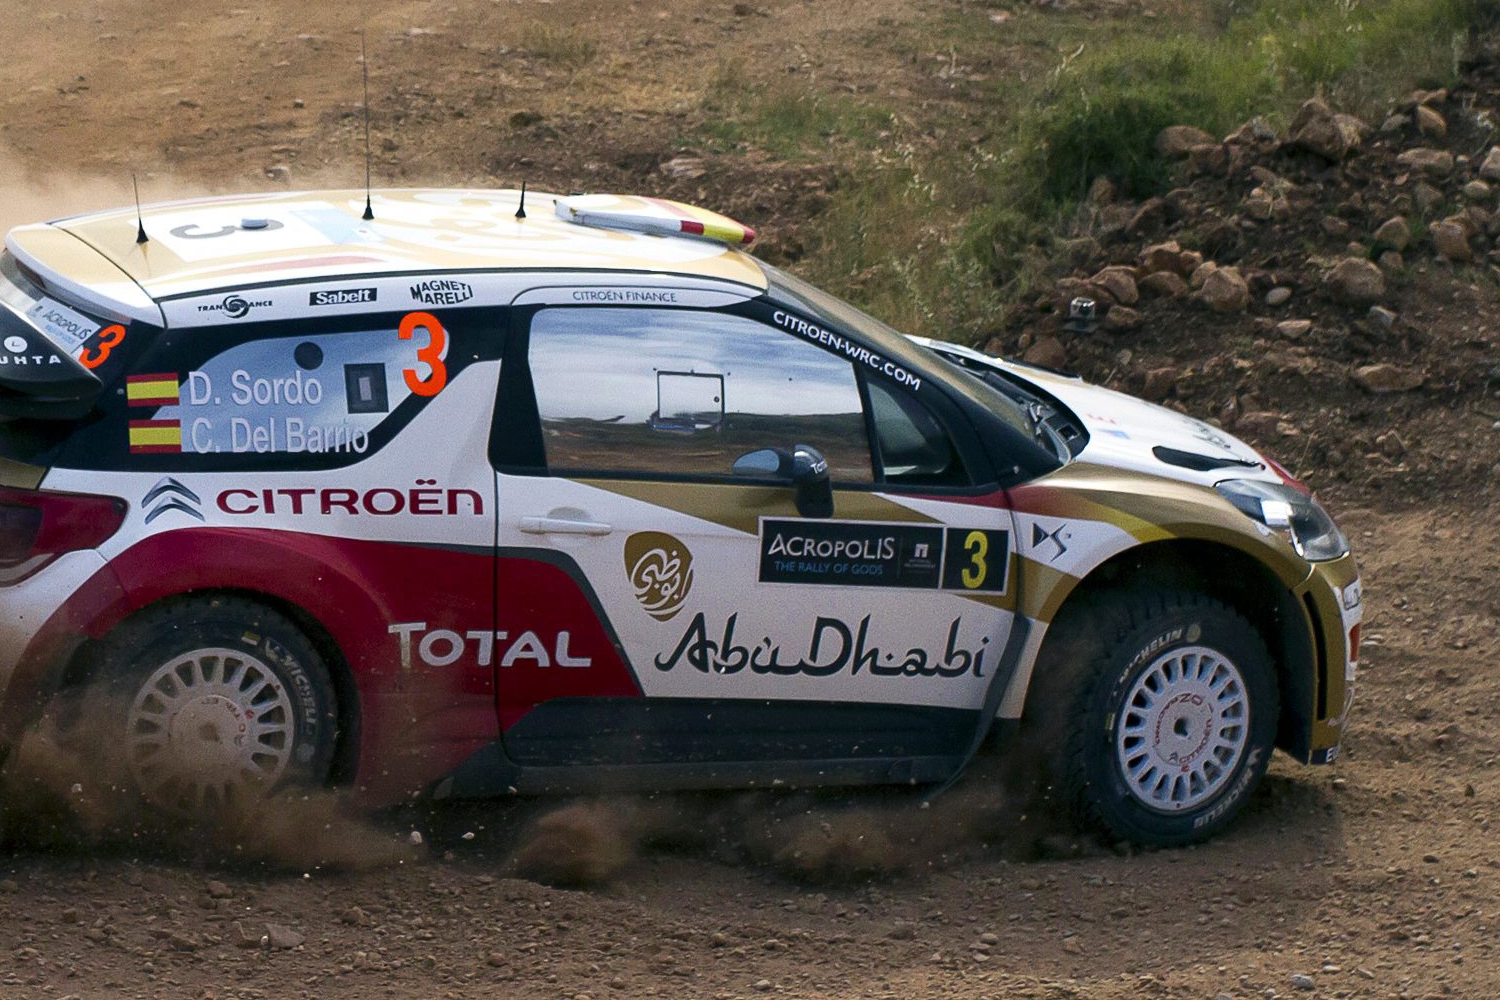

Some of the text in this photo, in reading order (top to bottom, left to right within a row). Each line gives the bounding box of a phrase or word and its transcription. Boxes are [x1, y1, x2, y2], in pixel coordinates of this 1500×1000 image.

[315, 289, 371, 304] Sabelt
[626, 291, 677, 303] FINANCE
[42, 310, 92, 340] ACROPOLIS
[78, 324, 126, 369] 3
[398, 312, 447, 397] 3
[773, 310, 921, 391] CITROEN-WRC.COM
[189, 369, 323, 405] D. Sordo
[192, 417, 369, 454] C. Del Barrio
[767, 533, 895, 560] ACROPOLIS
[961, 530, 989, 589] 3
[774, 561, 884, 575] THE RALLY OF GODS
[388, 622, 592, 668] TOTAL
[799, 614, 990, 678] Dhabi
